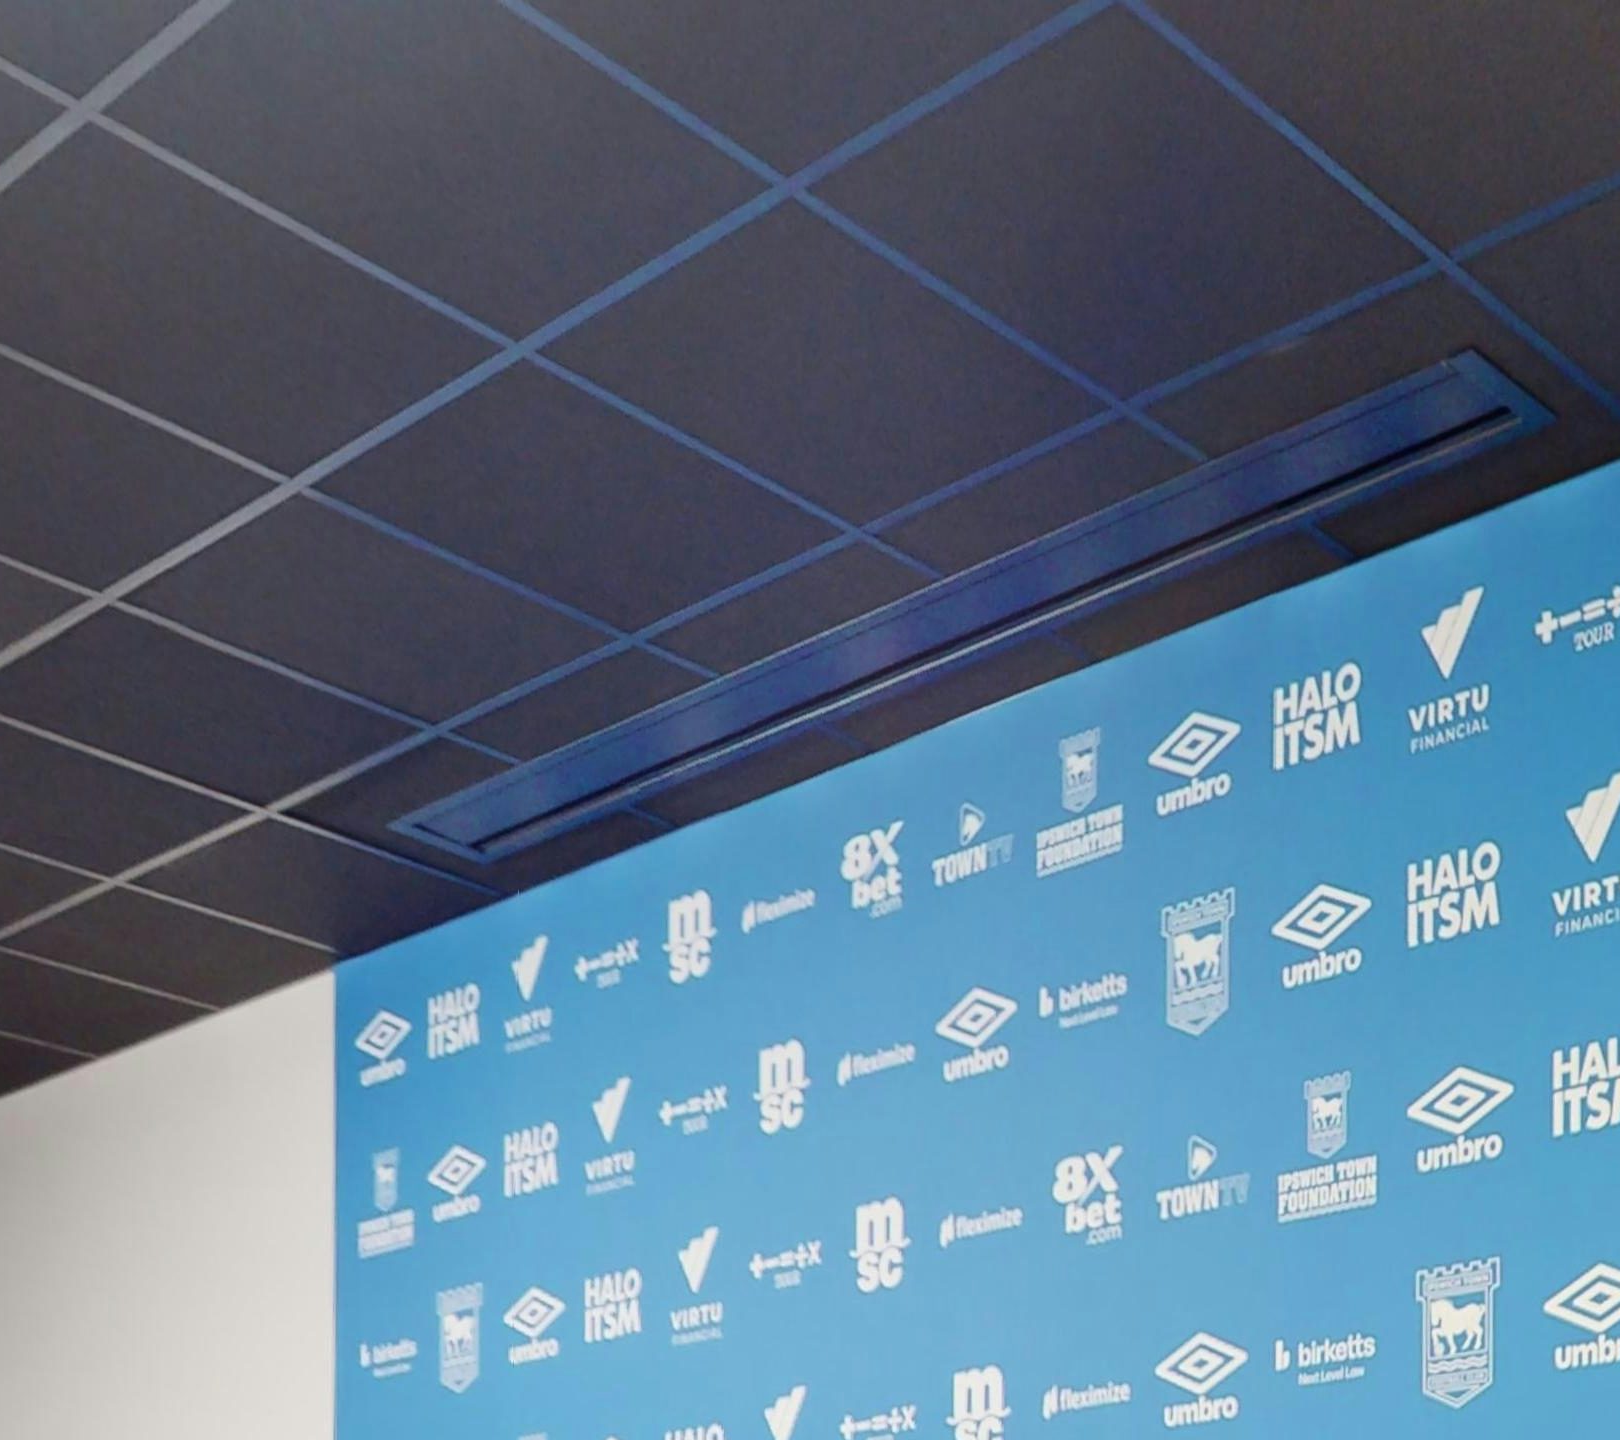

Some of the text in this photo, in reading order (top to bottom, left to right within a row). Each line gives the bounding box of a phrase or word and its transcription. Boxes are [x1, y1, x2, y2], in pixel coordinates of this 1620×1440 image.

[1574, 622, 1614, 651] TOUR
[1273, 663, 1361, 731] HALO
[1409, 685, 1489, 732] VIRTU
[1273, 702, 1360, 770] ITSM
[1410, 717, 1489, 753] FINANCIAL
[1157, 774, 1231, 816] umbro
[852, 867, 902, 908] bet
[1407, 842, 1500, 908] HALO
[1407, 882, 1499, 947] ITSM
[1282, 948, 1361, 988] umbro
[428, 984, 480, 1030] HALO
[943, 1045, 1009, 1081] umbro
[504, 1122, 559, 1167] HALO
[1417, 1135, 1502, 1172] umbro
[1335, 1156, 1377, 1185] TOWN
[1065, 1194, 1122, 1233] bet
[1278, 1177, 1377, 1217] FOUNDATION
[584, 1268, 642, 1312] HALO
[584, 1299, 641, 1342] ITSM
[671, 1302, 723, 1330] VIRTU
[1298, 1333, 1375, 1367] birketts
[1059, 1382, 1131, 1411] fleximize
[1164, 1394, 1239, 1427] umbro
